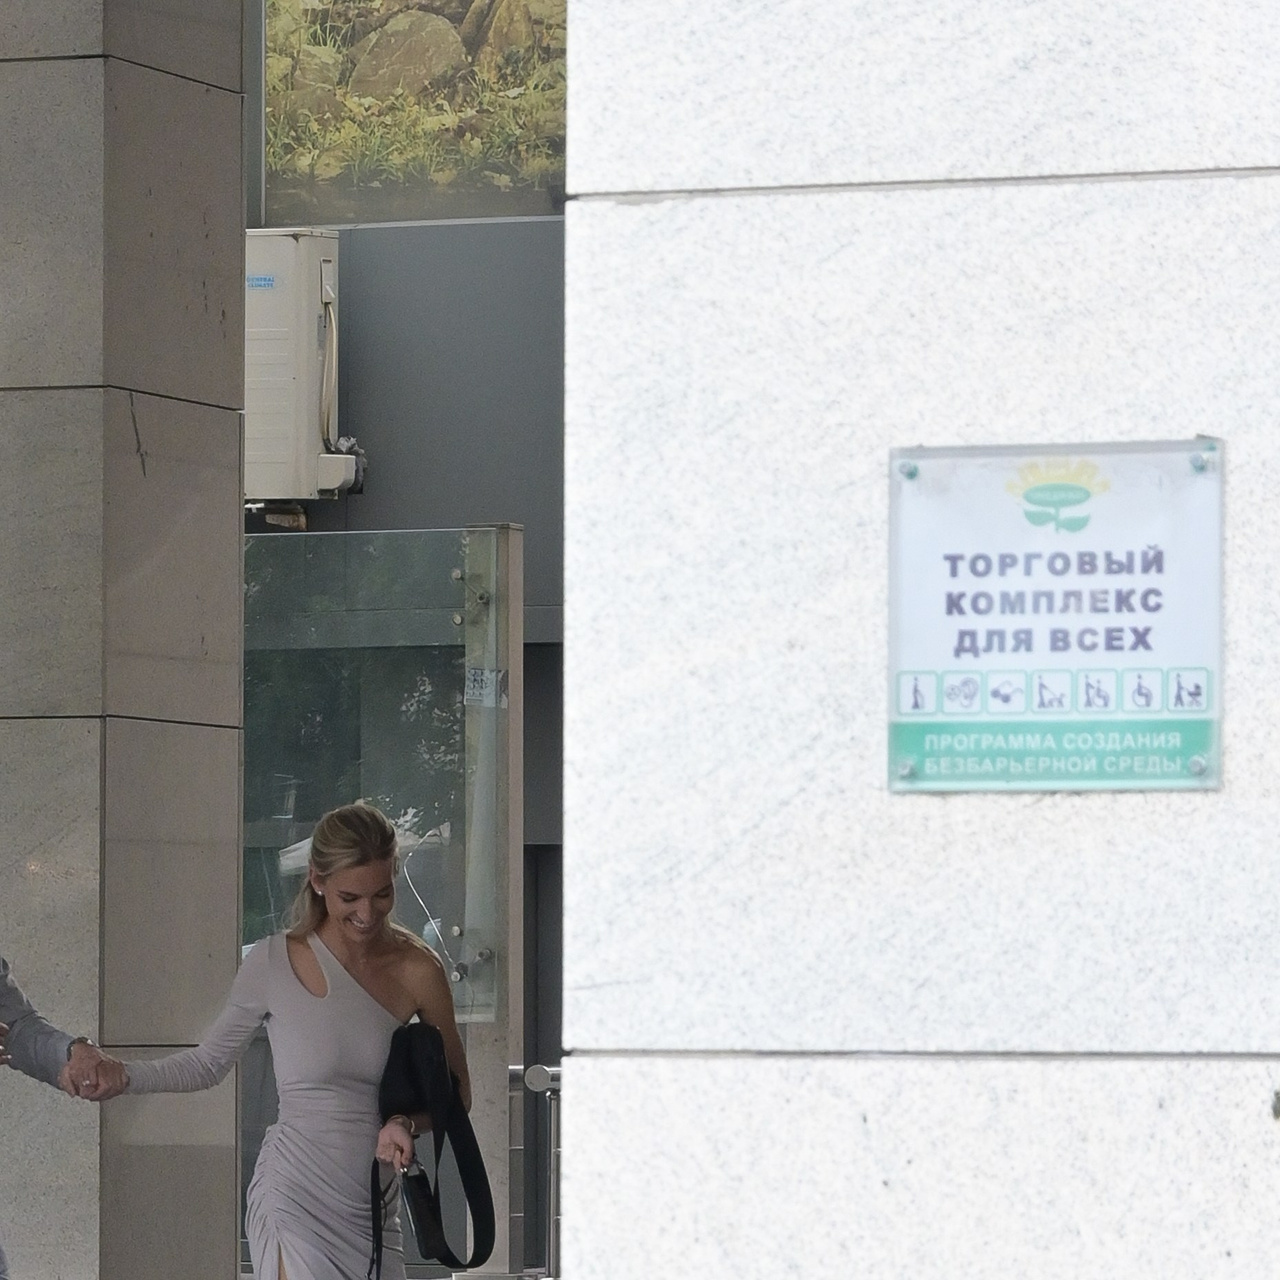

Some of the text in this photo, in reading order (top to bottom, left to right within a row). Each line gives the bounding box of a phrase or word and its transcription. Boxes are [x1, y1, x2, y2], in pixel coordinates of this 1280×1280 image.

[942, 544, 1164, 578] ТОРГОВЫЙ
[944, 587, 1163, 616] КОМПЛЕКС
[953, 626, 1154, 659] ДЛЯ ВСЕХ
[924, 731, 1182, 751] ПРОГРАММА СОЗДАНИЯ
[924, 754, 1183, 775] БЕЗБАРЬЕРНОЙ СРЕДЫ
